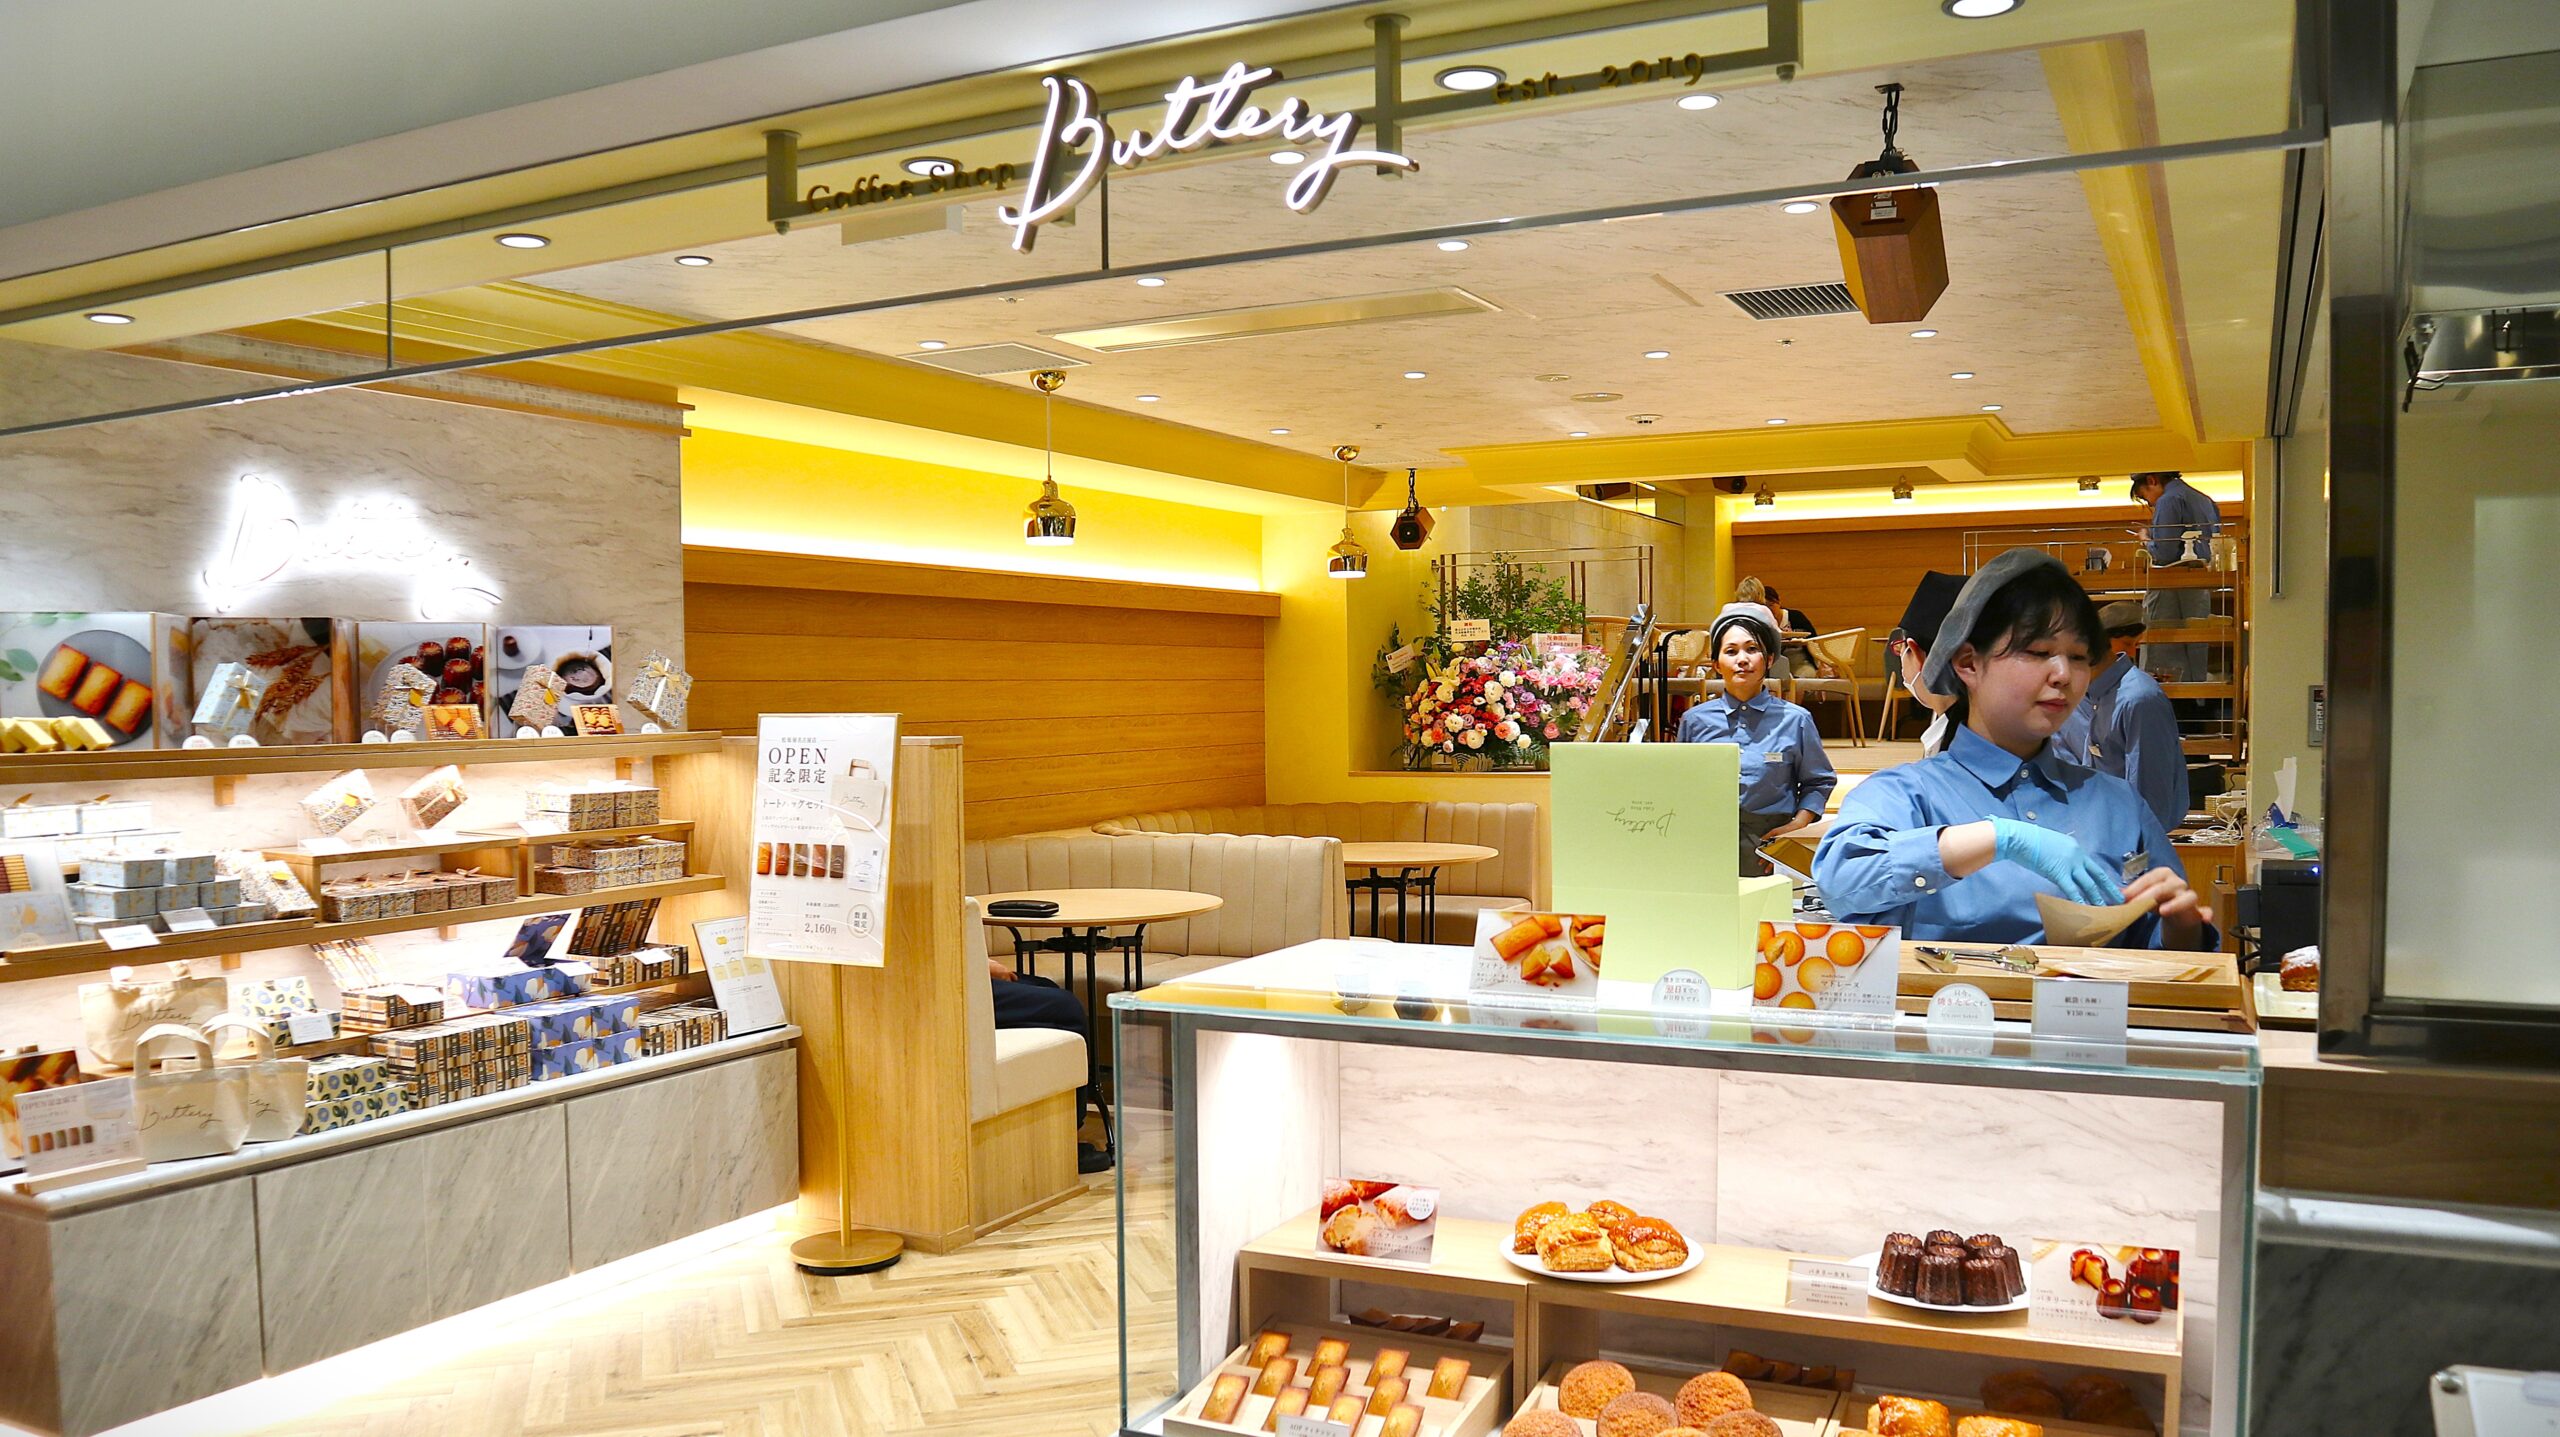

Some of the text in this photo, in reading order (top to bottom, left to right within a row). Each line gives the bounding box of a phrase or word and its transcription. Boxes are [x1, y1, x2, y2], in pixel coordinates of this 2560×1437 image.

[1497, 52, 1704, 105] est. 2019
[998, 62, 1420, 254] Buttery
[806, 158, 1016, 214] Coffee Shop
[768, 747, 828, 765] OPEN
[768, 768, 828, 784] 記念限定
[1605, 807, 1677, 838] Buttery
[138, 1103, 224, 1132] Buttery
